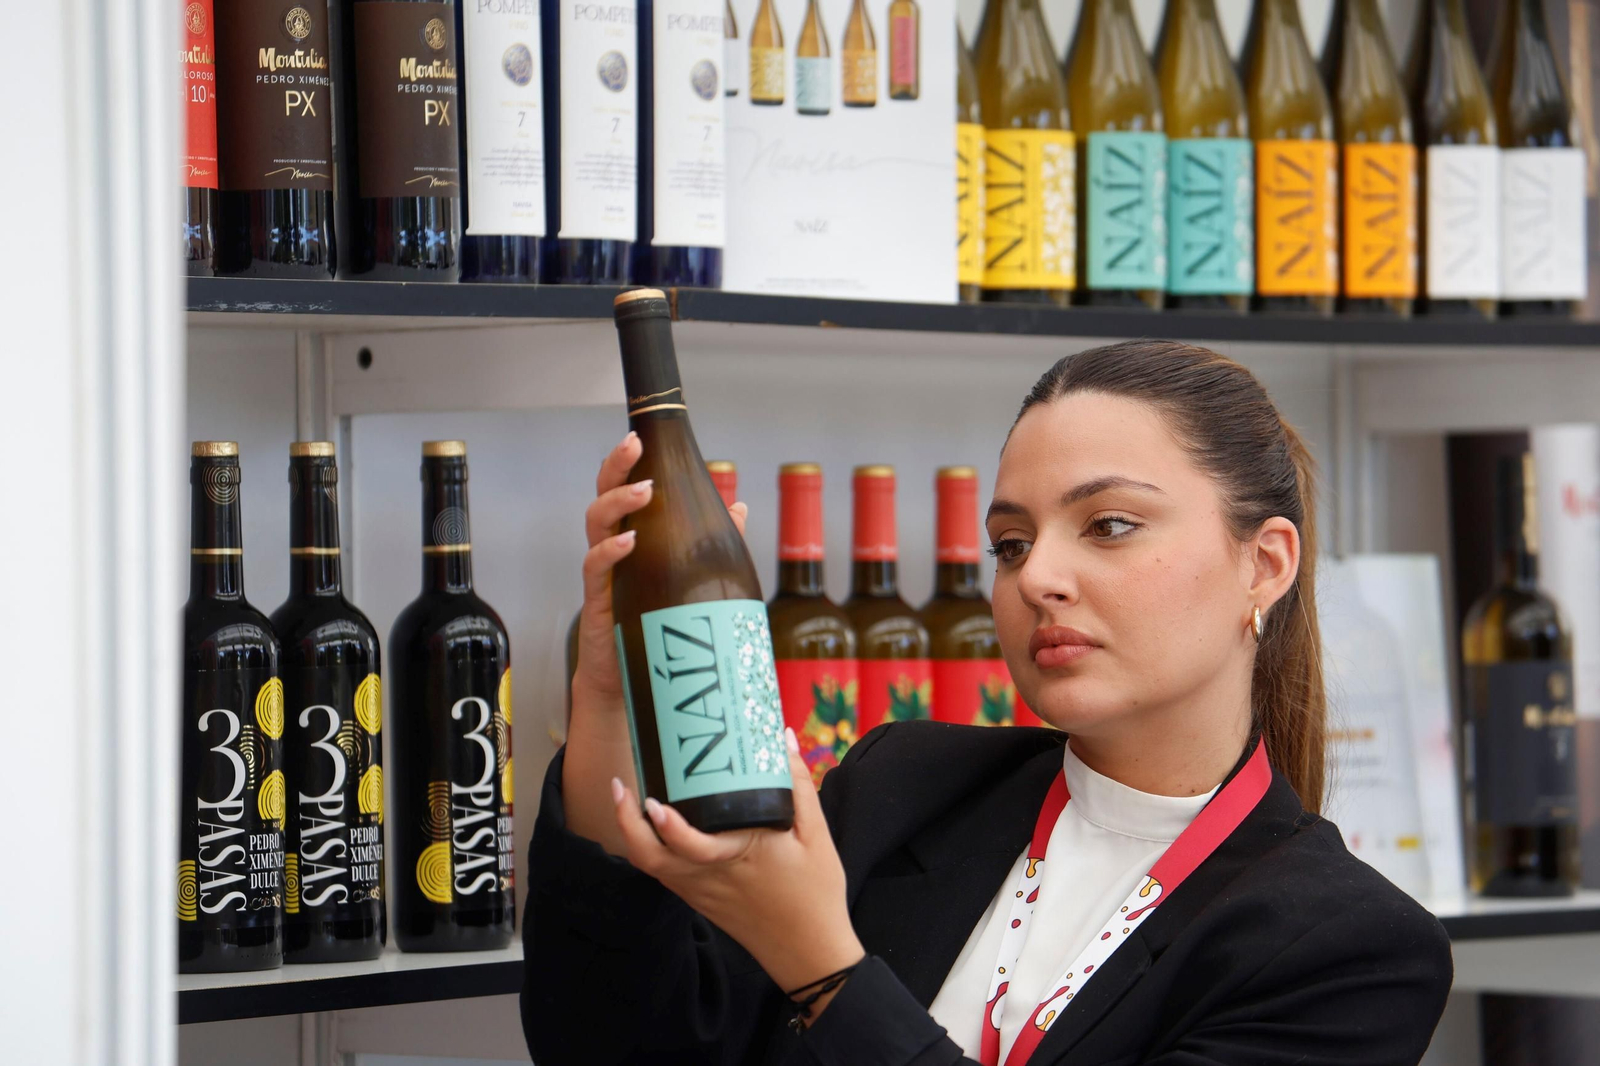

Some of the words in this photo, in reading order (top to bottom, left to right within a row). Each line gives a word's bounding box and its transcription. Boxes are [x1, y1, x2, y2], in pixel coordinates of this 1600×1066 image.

[259, 48, 328, 73] Montulia
[400, 58, 457, 82] Montulia
[256, 75, 294, 84] PEDRO
[397, 84, 433, 94] PEDRO
[191, 85, 208, 103] 10
[285, 90, 317, 117] PX
[424, 100, 450, 126] PX
[517, 111, 526, 128] 7
[611, 116, 620, 133] 7
[703, 125, 712, 141] 7
[1093, 141, 1146, 273] NAÍZ
[1170, 148, 1226, 278] NAÍZ
[1262, 151, 1316, 278] NAÍZ
[654, 616, 734, 783] NAÍZ
[298, 705, 346, 803] 3
[451, 696, 495, 795] 3
[198, 709, 247, 808] 3
[249, 832, 280, 851] PEDRO
[350, 825, 379, 845] PEDRO
[451, 782, 498, 896] PASAS
[197, 797, 248, 914] PASAS
[298, 792, 348, 908] PASAS
[250, 871, 280, 889] DULCE
[351, 863, 379, 882] DULCE
